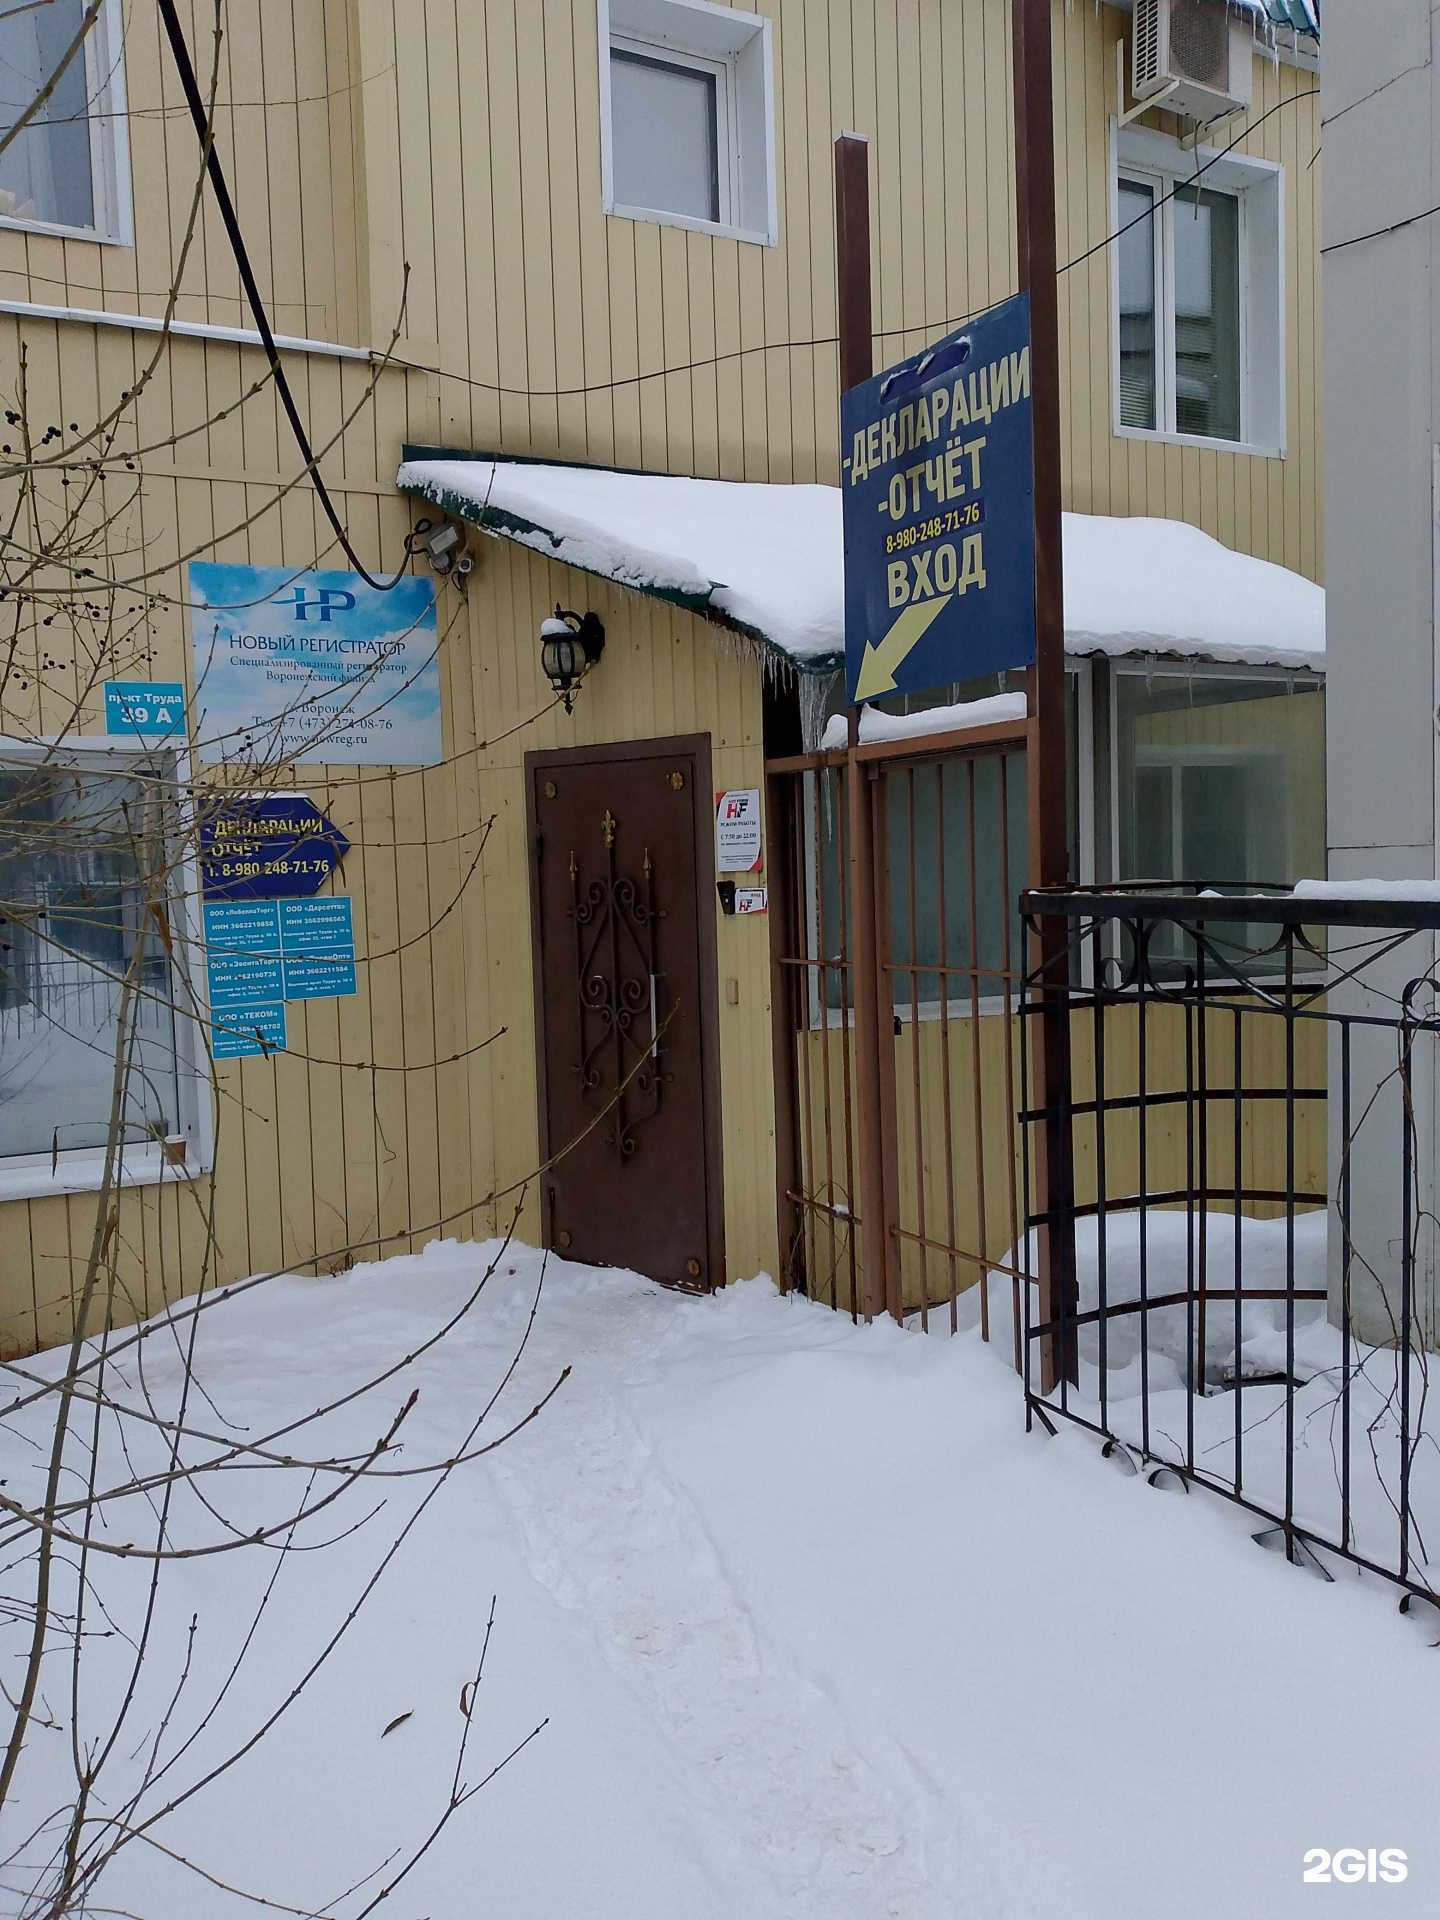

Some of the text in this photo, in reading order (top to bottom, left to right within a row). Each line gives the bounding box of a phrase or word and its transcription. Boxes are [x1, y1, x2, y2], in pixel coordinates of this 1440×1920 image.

[843, 346, 1031, 486] -ДЕКЛАРАЦИИ
[878, 436, 987, 521] -ОТЧЁТ
[886, 502, 980, 553] 8-980-248-71-76
[887, 533, 987, 608] ВХОД
[229, 634, 406, 656] НОВЫЙ РЕГИСТРАТОР
[347, 662, 407, 674] региратор
[144, 693, 182, 705] Труда
[121, 707, 173, 723] 39 А
[283, 734, 368, 748] wwwnewreg.ru
[222, 863, 260, 877] 8-980
[264, 860, 330, 875] 248-71-76
[286, 904, 303, 913] ООО
